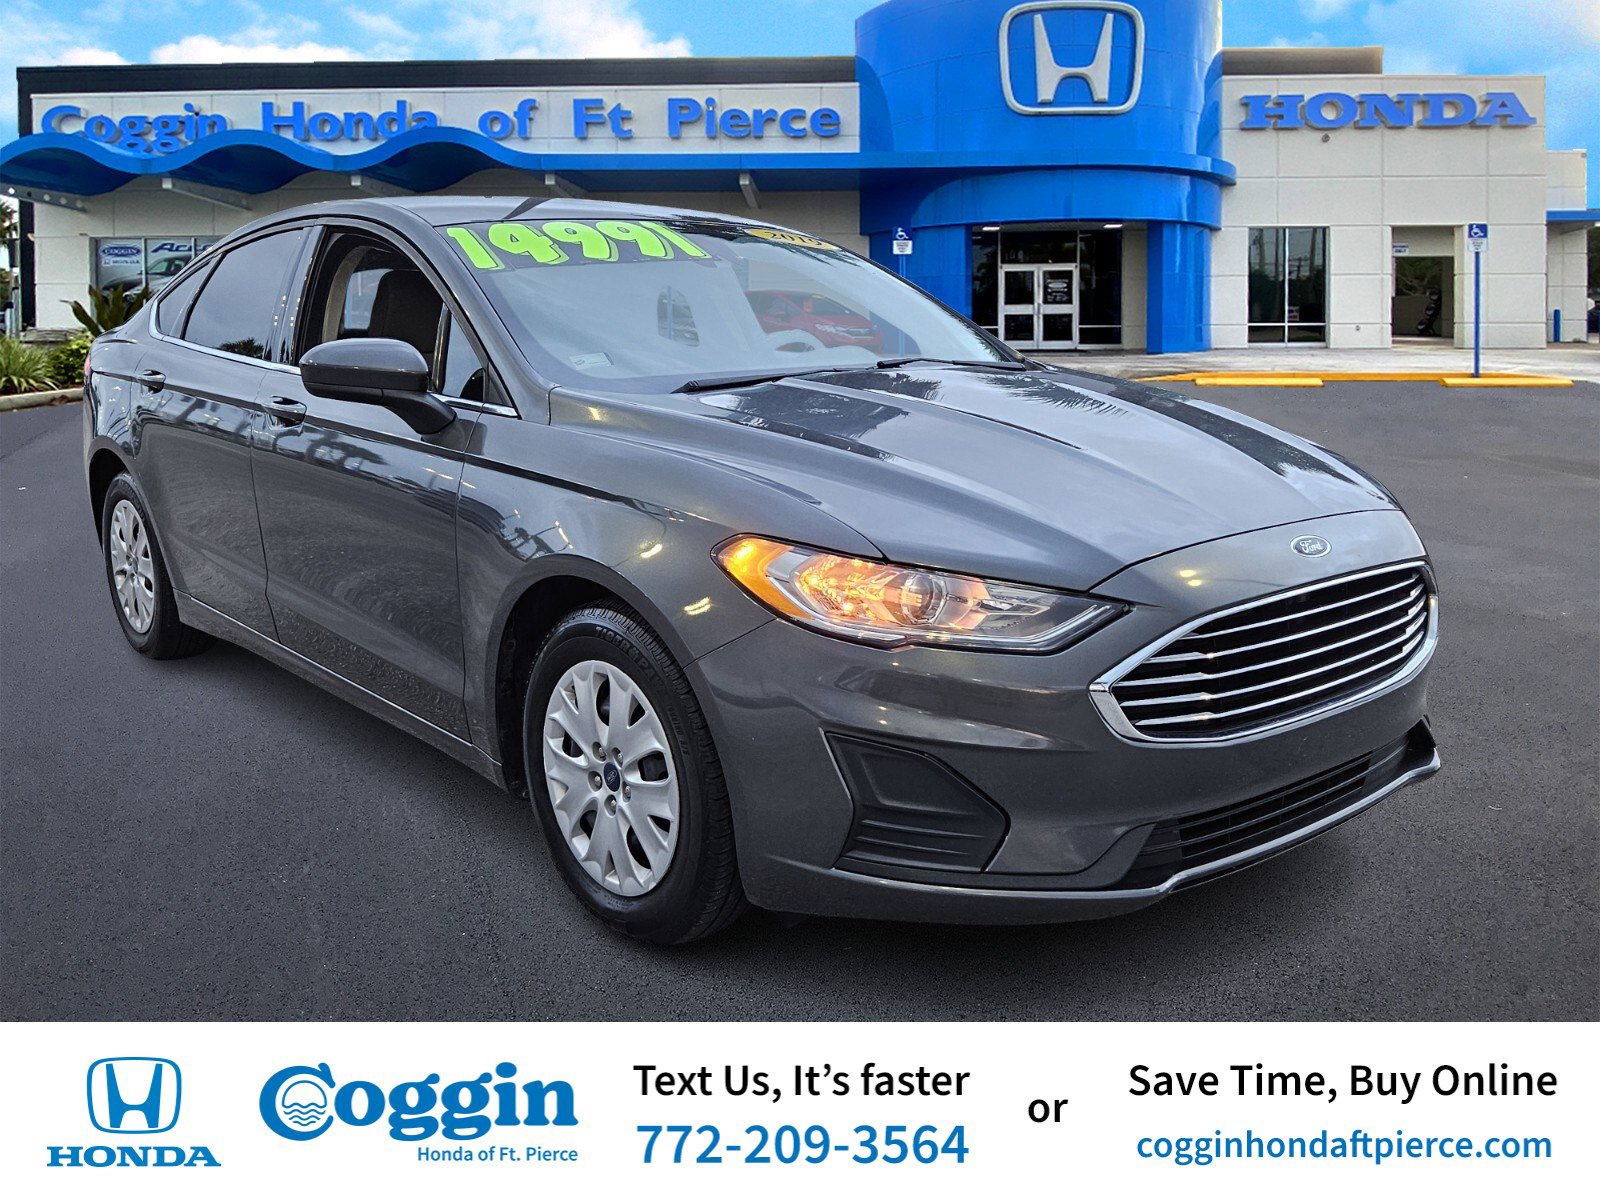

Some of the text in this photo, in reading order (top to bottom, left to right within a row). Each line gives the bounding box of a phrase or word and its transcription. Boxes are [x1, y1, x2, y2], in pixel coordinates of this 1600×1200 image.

[42, 97, 841, 155] Coggin Honda of Ft Pierce
[1241, 92, 1538, 130] HONDA
[446, 221, 713, 270] 14991
[1299, 539, 1323, 553] Ford
